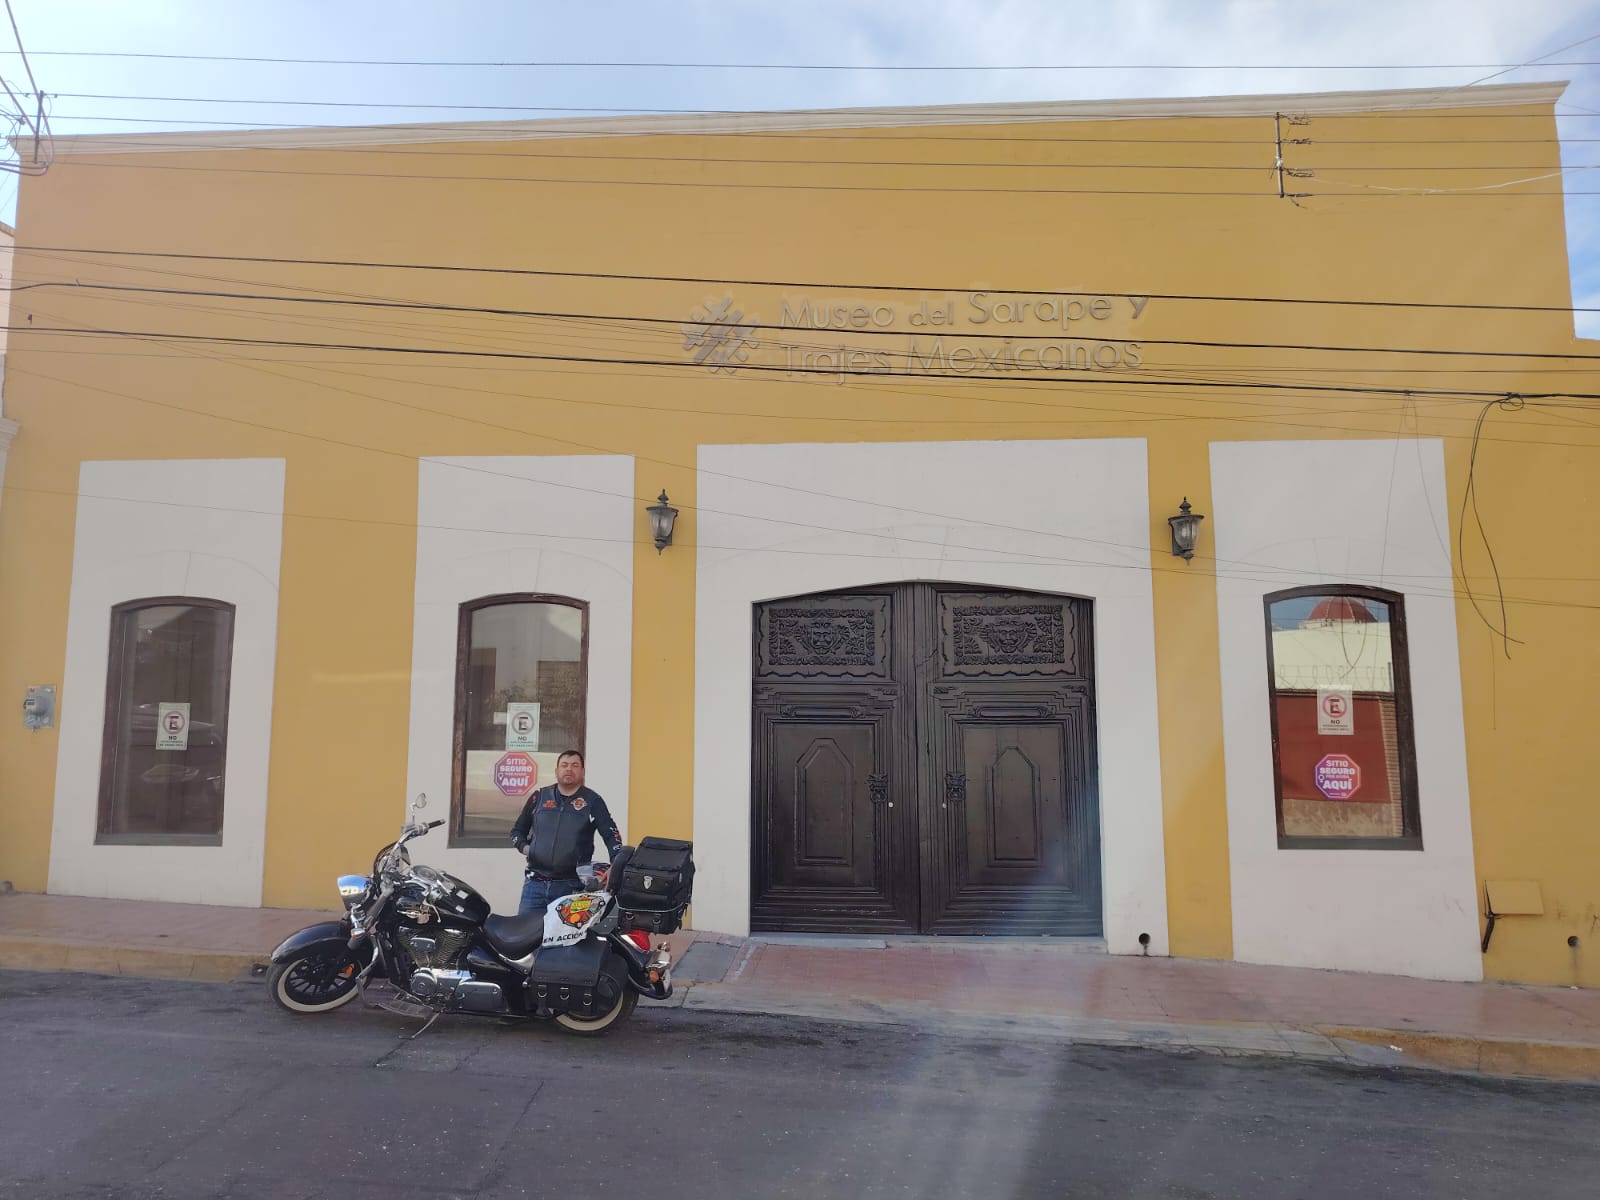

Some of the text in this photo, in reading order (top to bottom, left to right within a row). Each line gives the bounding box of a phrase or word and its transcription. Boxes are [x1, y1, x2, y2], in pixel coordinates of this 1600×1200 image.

[780, 299, 895, 330] Museo
[908, 300, 953, 327] del
[968, 291, 1112, 331] Sarape
[780, 336, 1144, 385] Trajes Mexicanos
[1320, 767, 1355, 775] SEGURO
[502, 776, 529, 786] AQUÍ
[1323, 779, 1352, 790] AQUÍ
